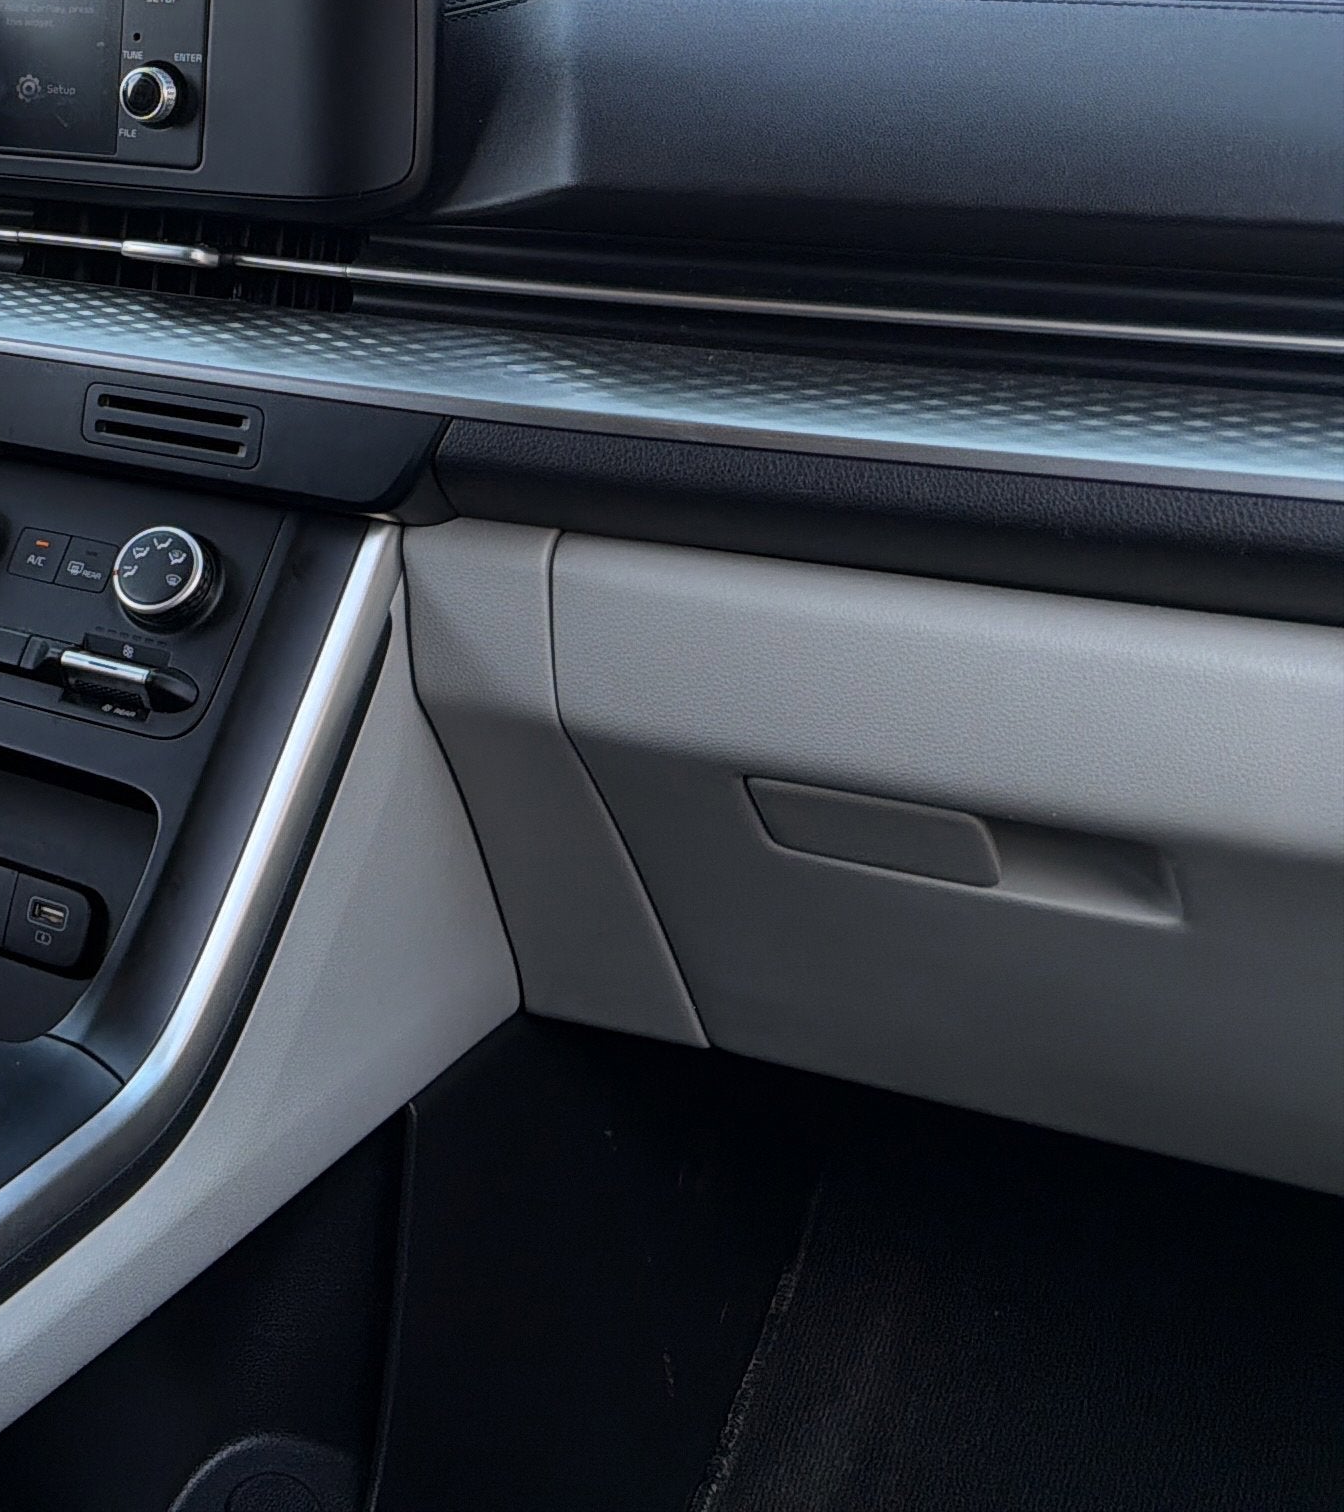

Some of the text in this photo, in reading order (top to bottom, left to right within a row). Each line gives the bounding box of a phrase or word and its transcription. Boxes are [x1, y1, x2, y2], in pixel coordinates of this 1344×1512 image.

[122, 50, 144, 60] TUNE
[173, 52, 203, 63] ENTER
[47, 84, 76, 96] Setup
[119, 128, 137, 138] FILE
[26, 553, 47, 567] A/C
